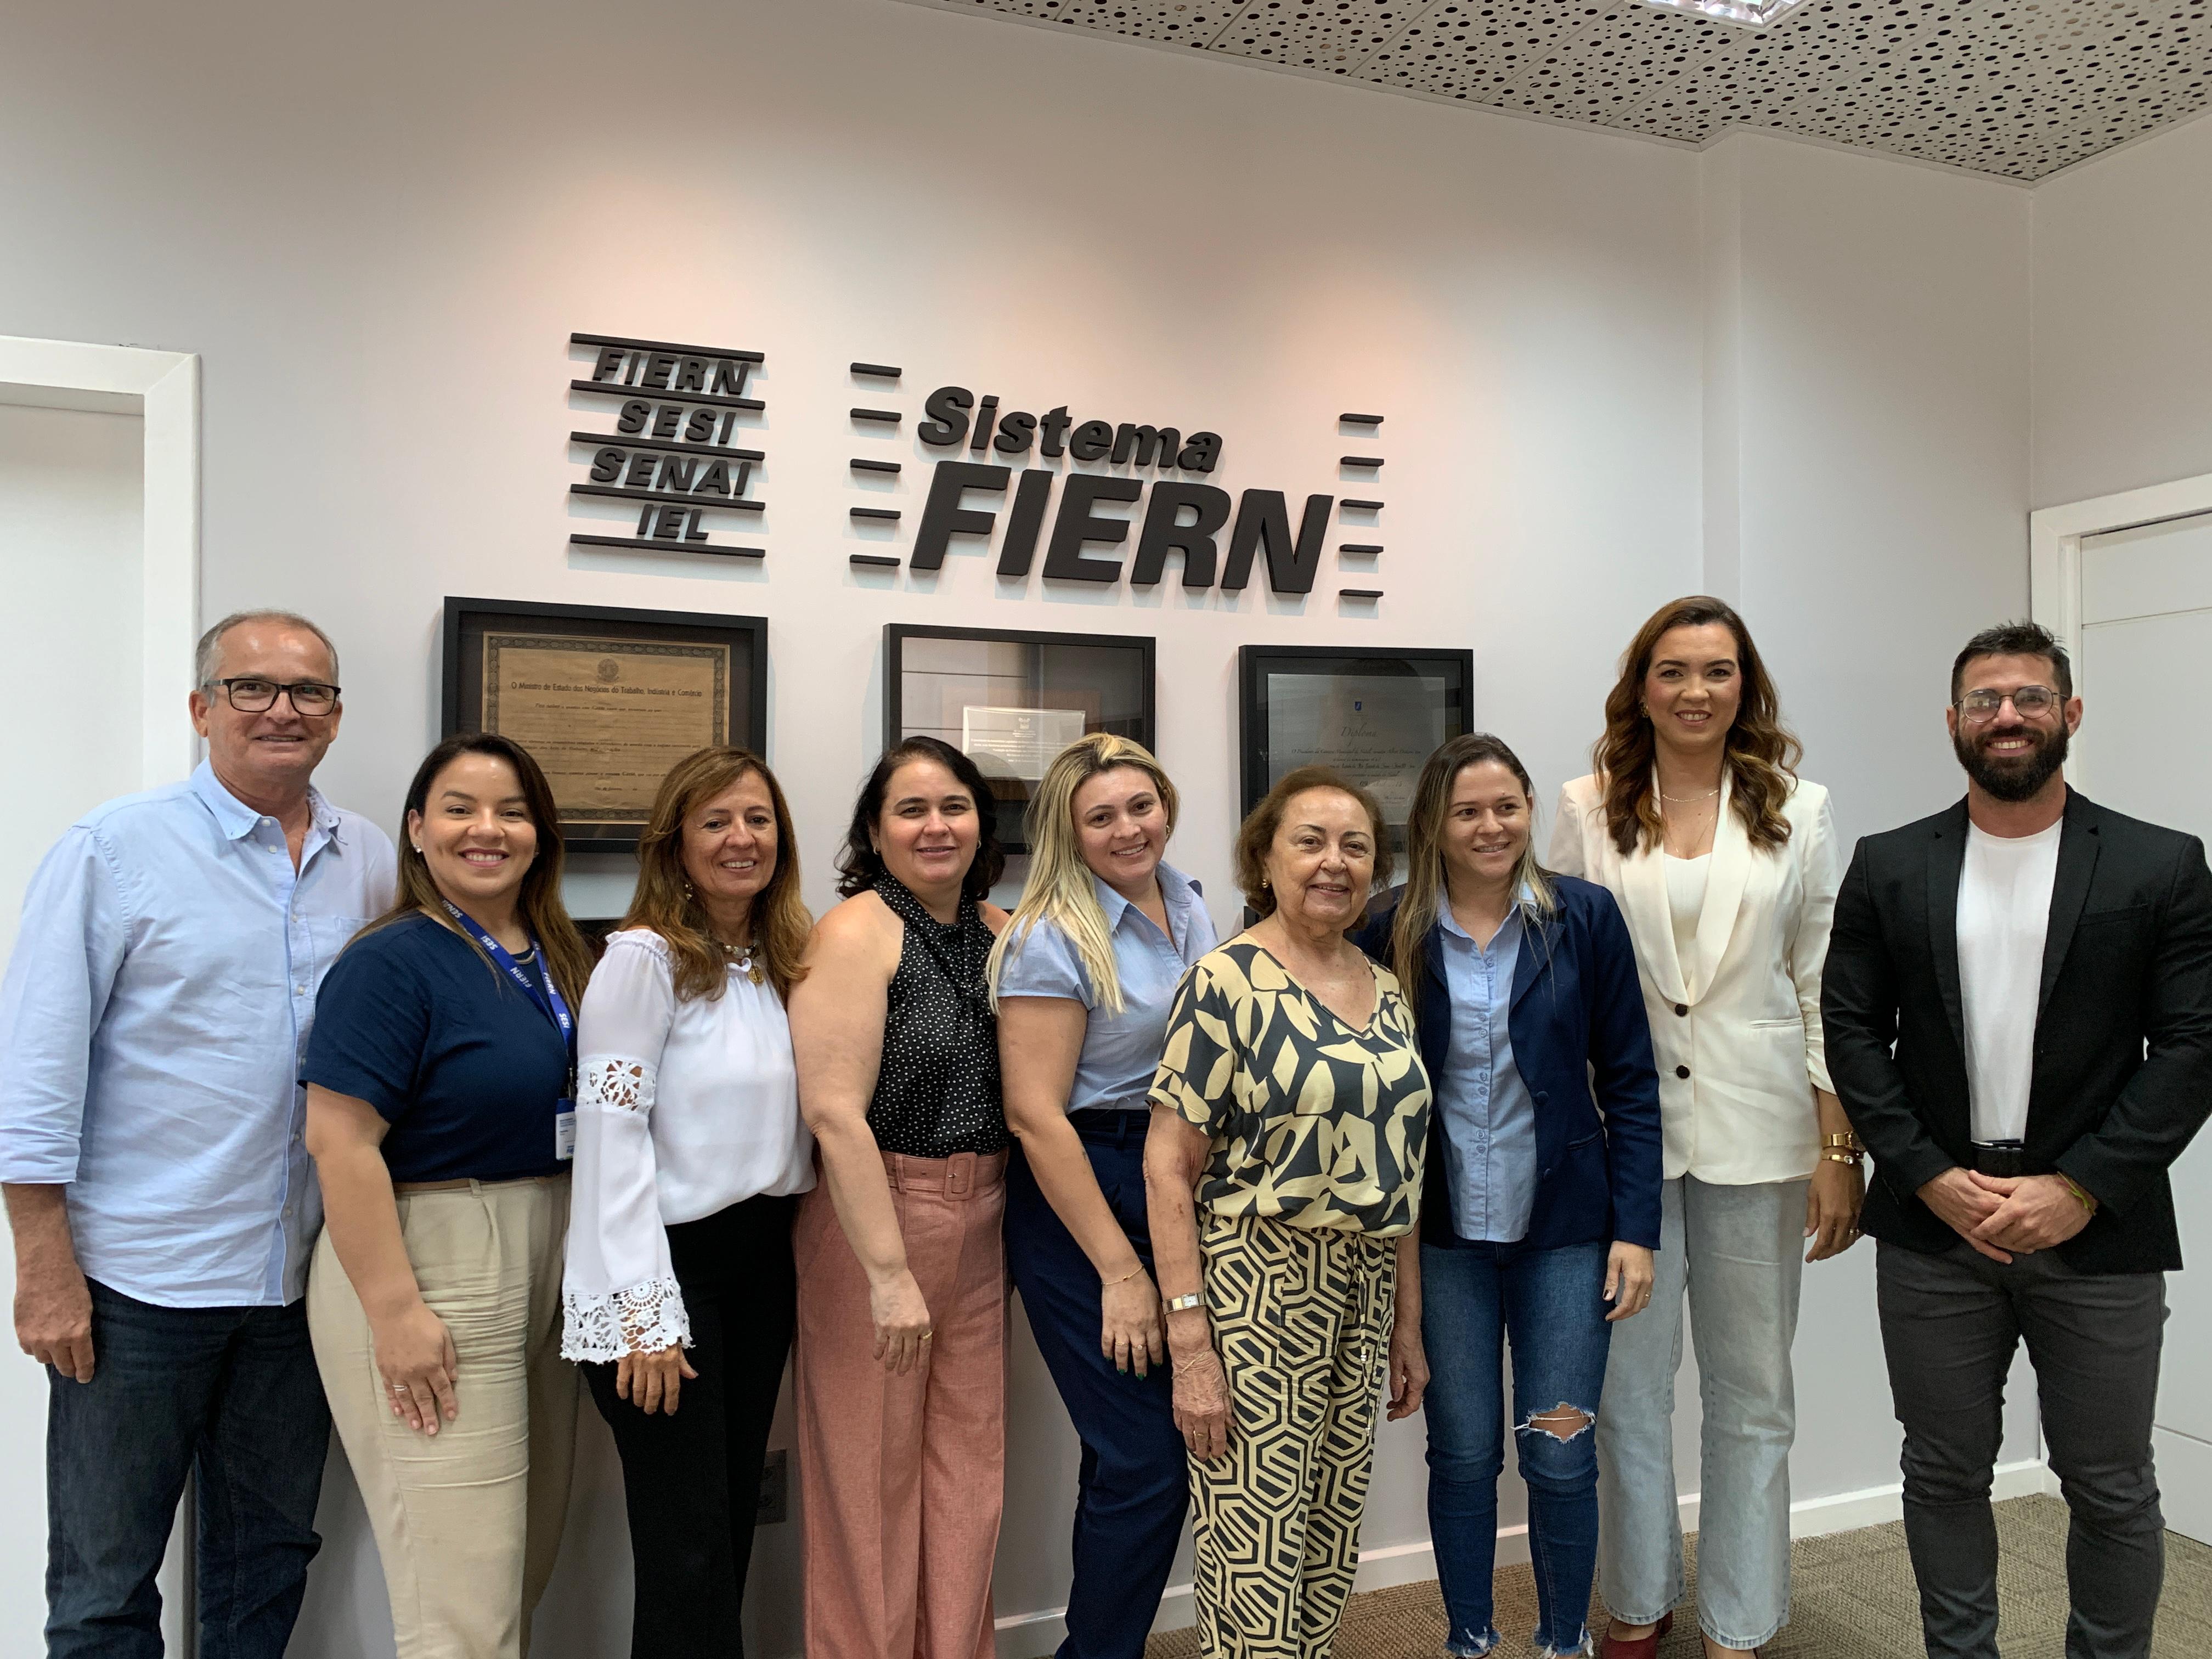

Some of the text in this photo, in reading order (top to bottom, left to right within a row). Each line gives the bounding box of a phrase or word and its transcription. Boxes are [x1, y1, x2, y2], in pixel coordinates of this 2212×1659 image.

[592, 347, 750, 395] FIERN
[618, 400, 736, 444] SESI
[918, 386, 1223, 473] Sistema
[590, 447, 752, 495] SENAI
[637, 504, 709, 540] IEL
[910, 460, 1334, 593] FIERN
[481, 935, 498, 950] SESI
[510, 967, 532, 988] FIERN
[544, 972, 556, 995] FIERN
[559, 1013, 571, 1028] SESI
